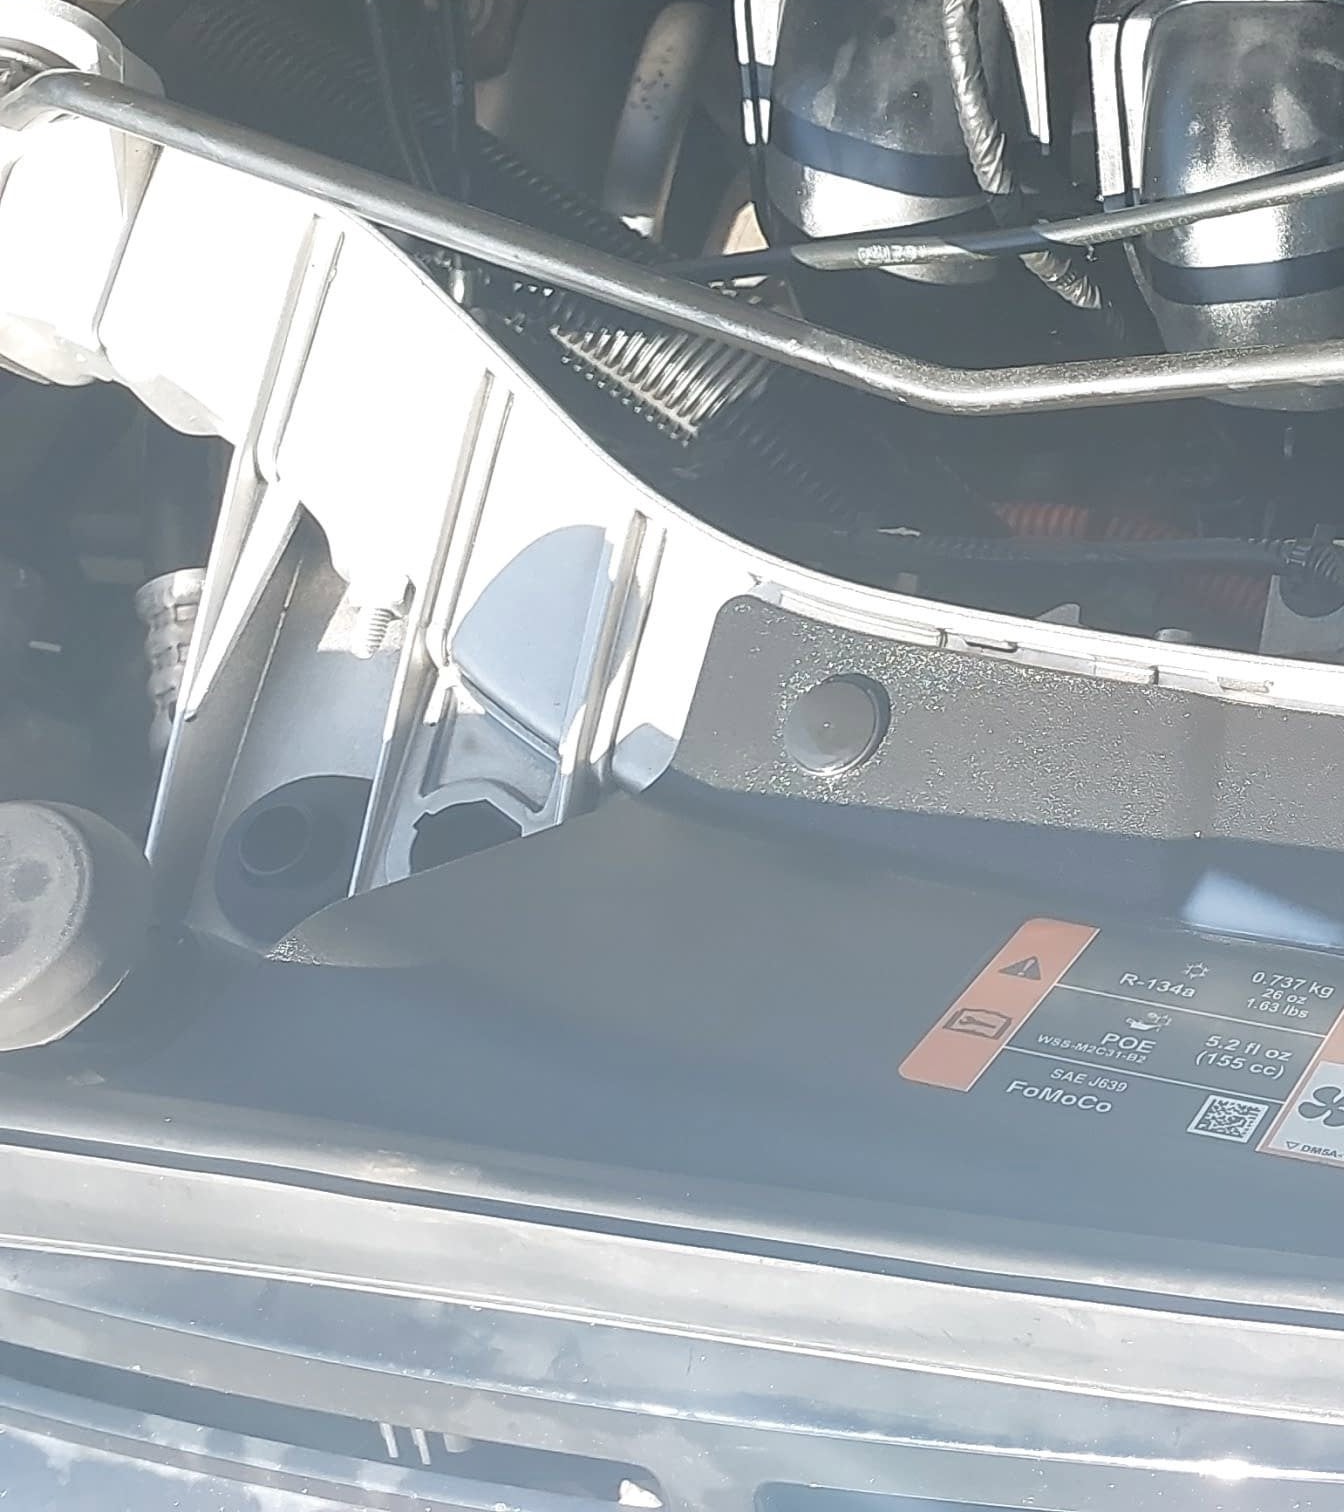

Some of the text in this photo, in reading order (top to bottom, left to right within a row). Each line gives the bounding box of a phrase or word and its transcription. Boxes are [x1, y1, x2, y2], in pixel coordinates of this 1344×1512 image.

[1119, 972, 1197, 997] R-134a
[1251, 970, 1335, 999] 0.737 kg
[1261, 987, 1308, 1005] 26 oz
[1246, 998, 1310, 1019] 1.63 lbs
[1100, 1032, 1157, 1054] POE
[1205, 1034, 1294, 1063] 5.2 fl oz
[1195, 1050, 1285, 1080] (155 cc)
[1050, 1068, 1129, 1093] SAE J639
[1005, 1079, 1113, 1113] FoMoCo
